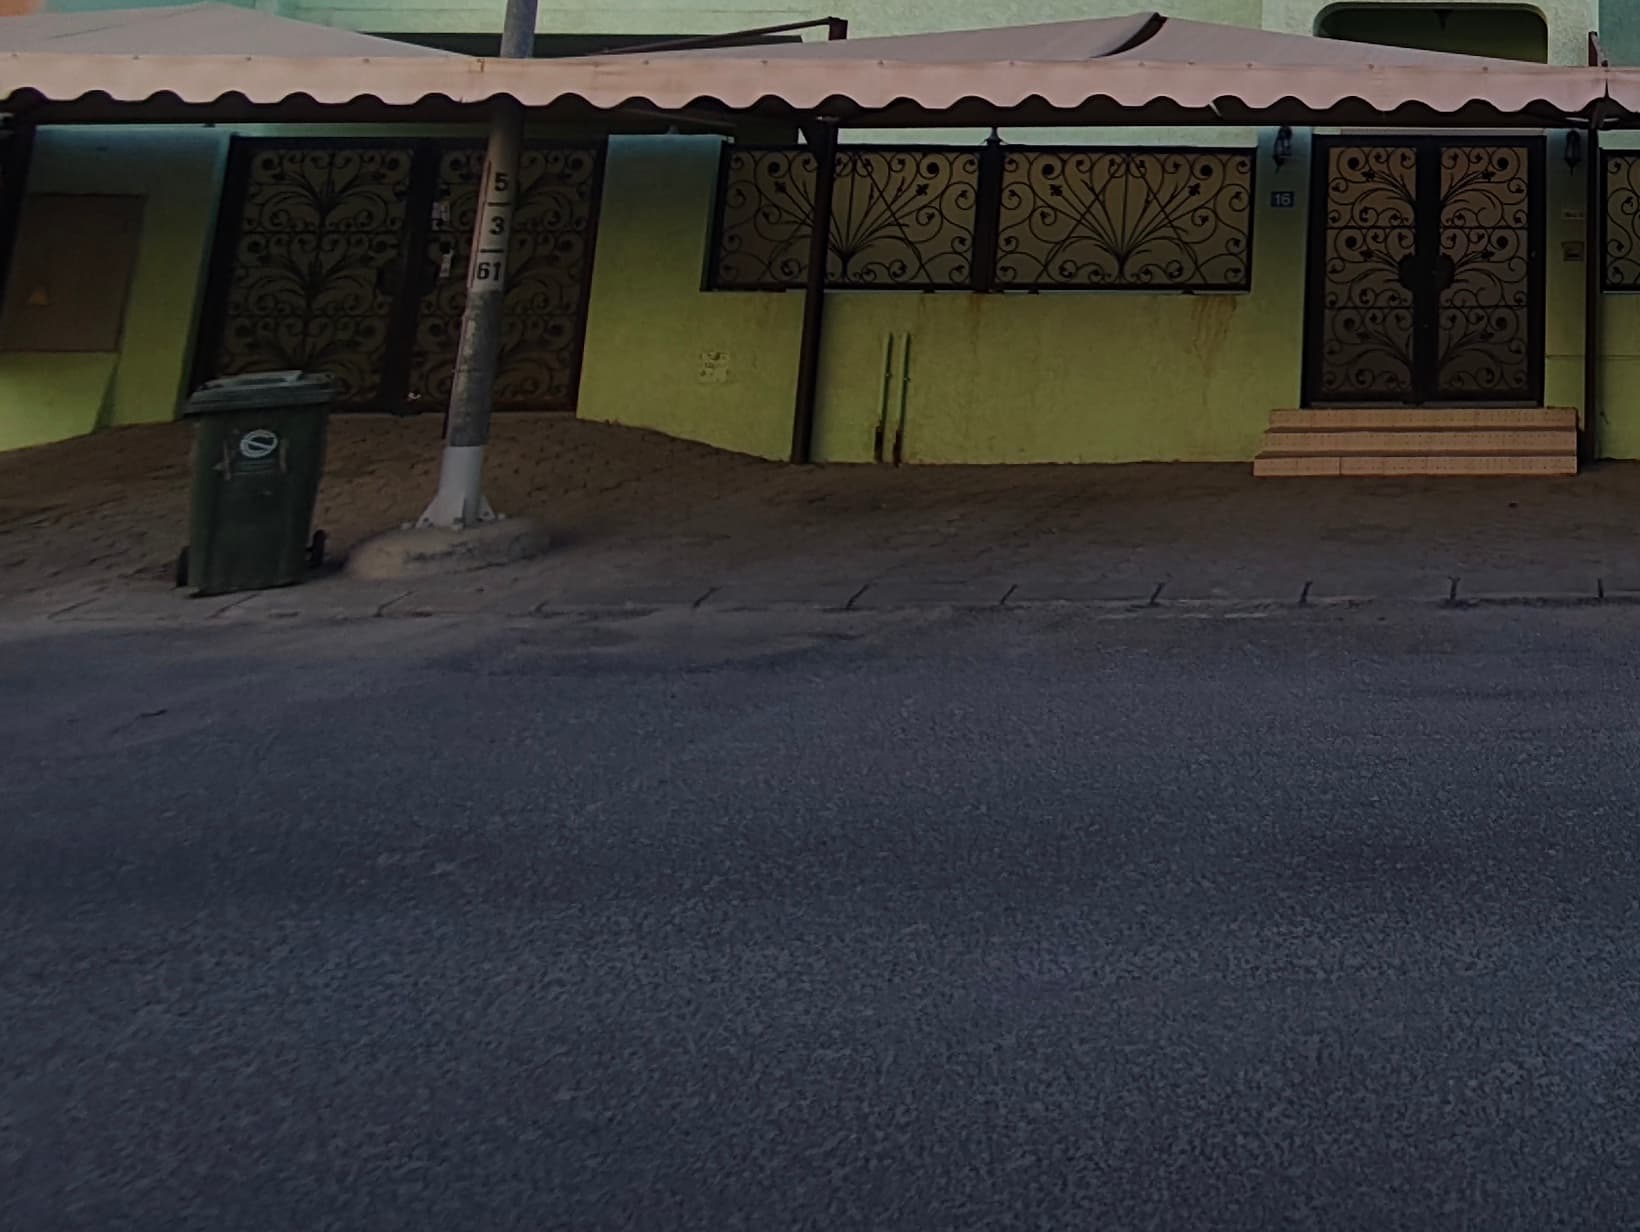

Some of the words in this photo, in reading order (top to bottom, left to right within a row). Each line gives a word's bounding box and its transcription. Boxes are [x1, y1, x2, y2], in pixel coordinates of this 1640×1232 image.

[495, 173, 508, 192] 5
[1276, 193, 1291, 206] 16
[490, 216, 505, 235] 3
[477, 262, 501, 280] 61
